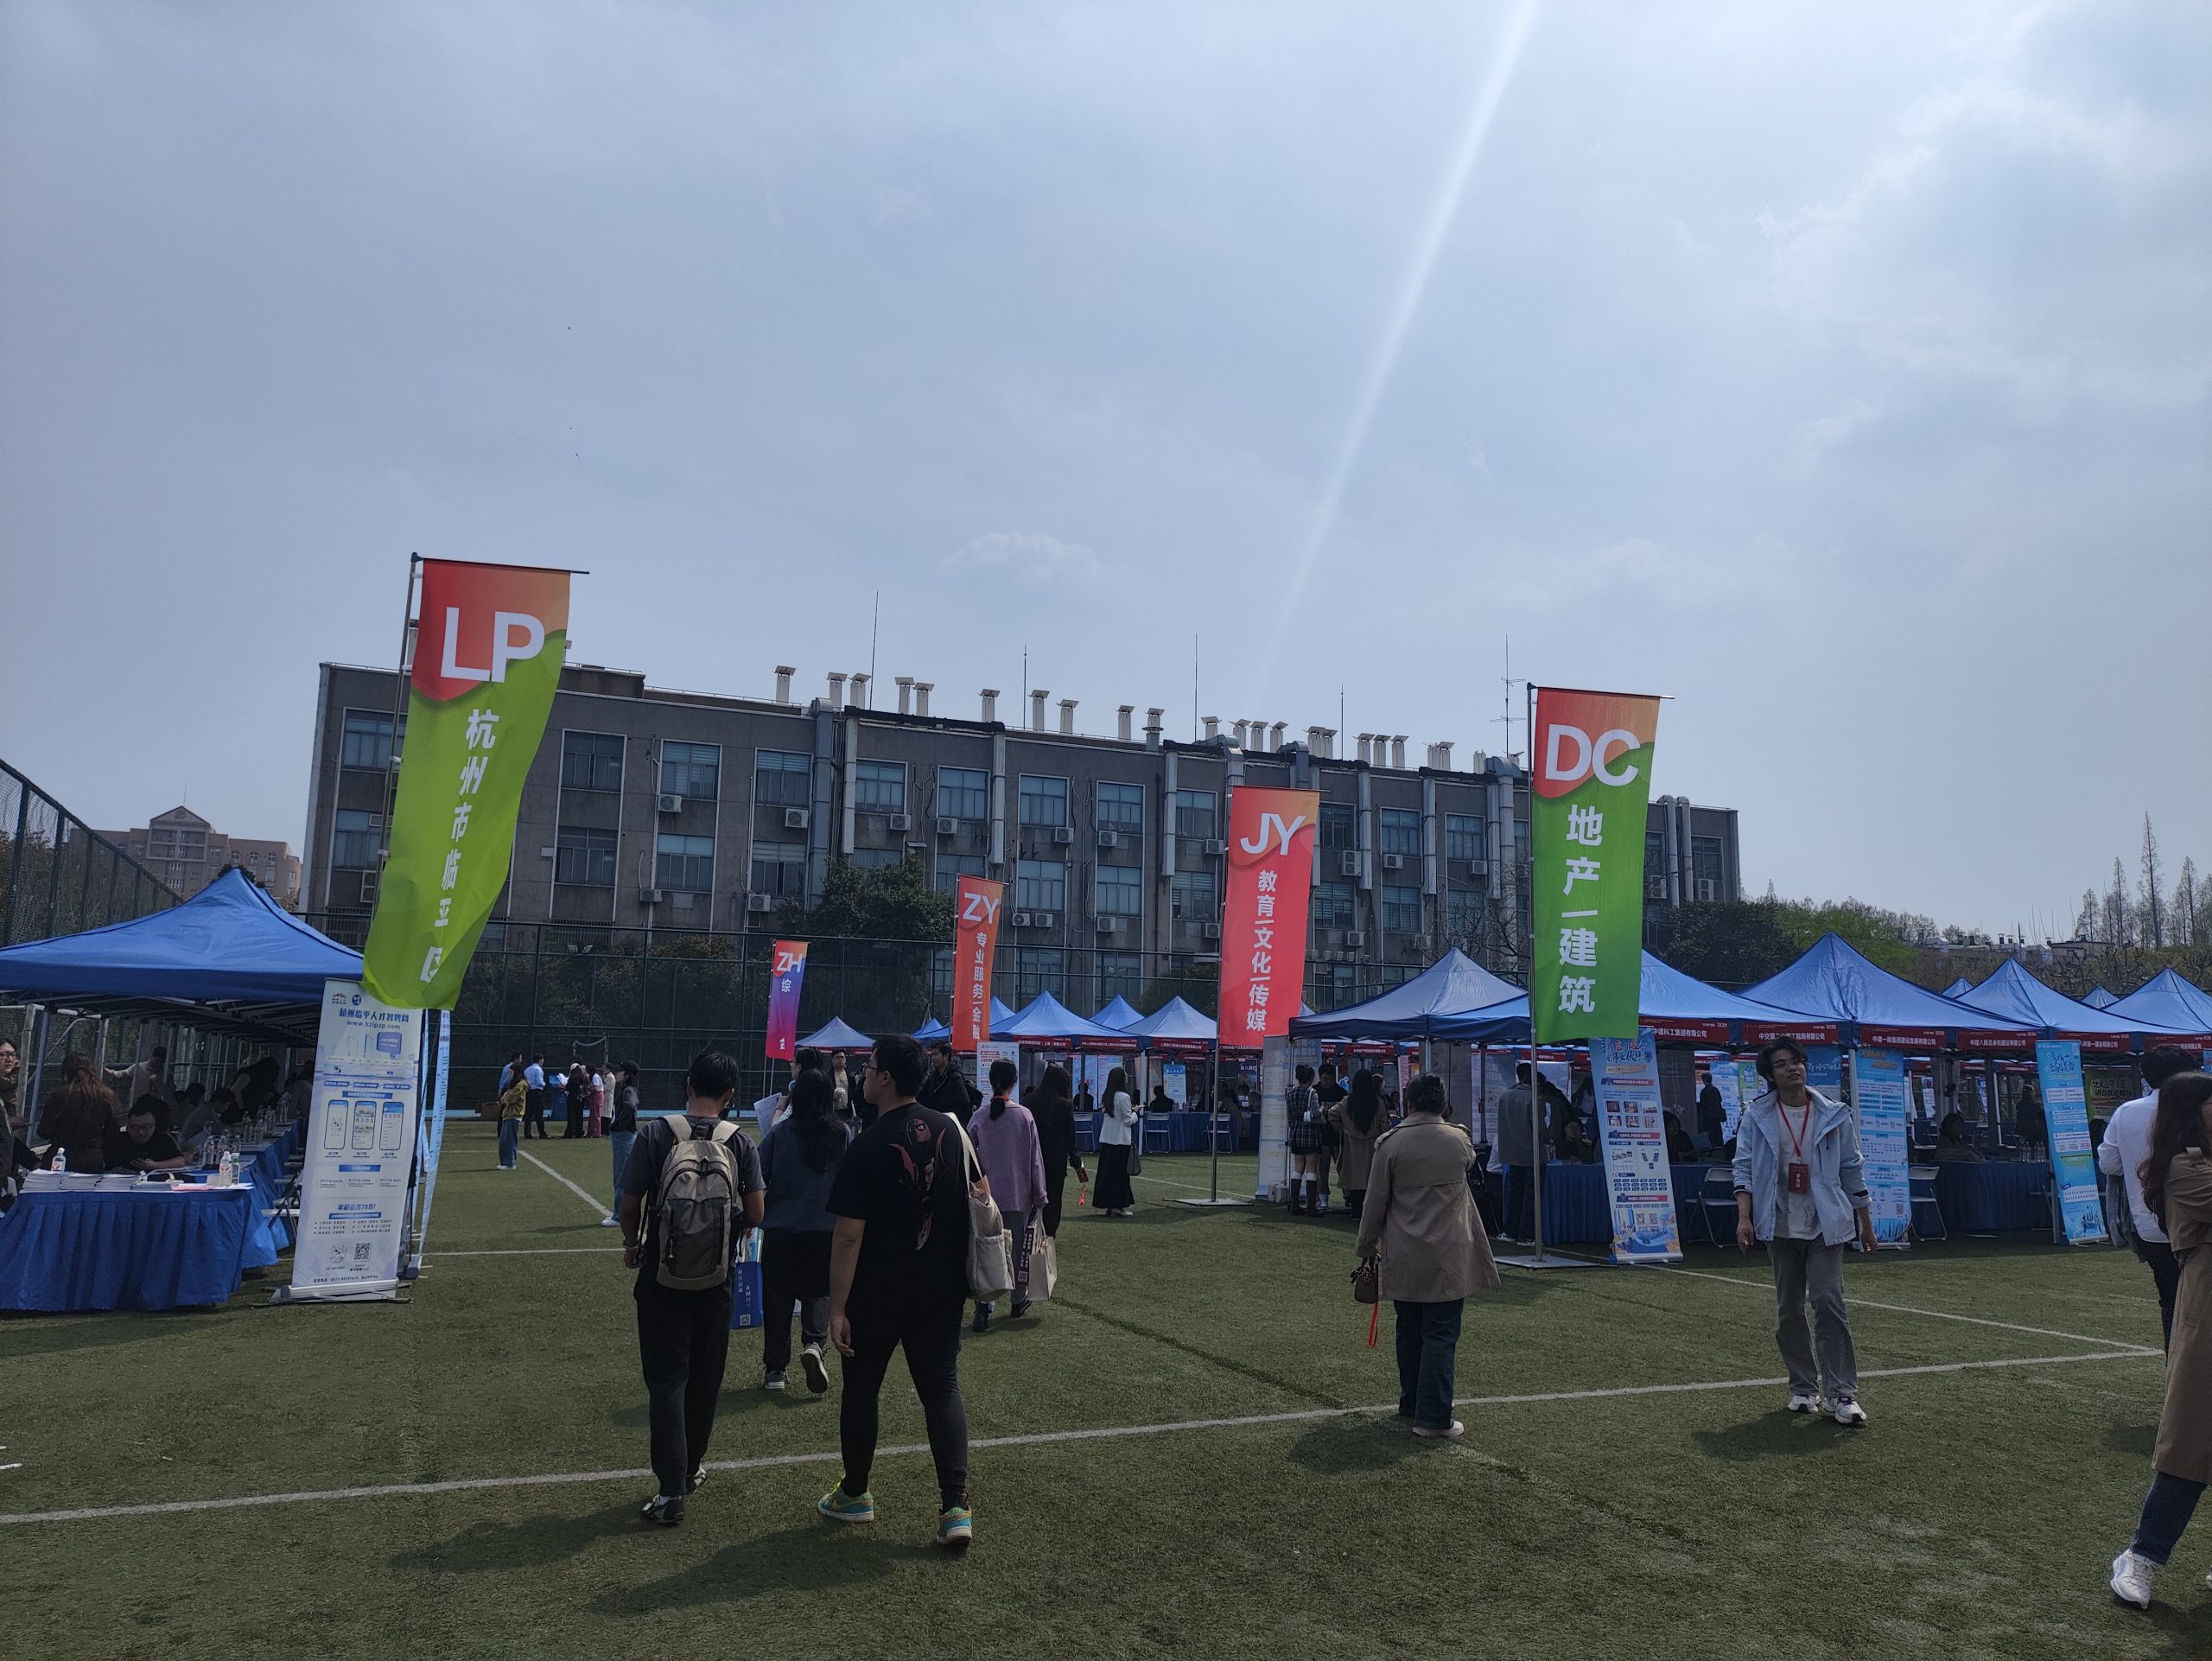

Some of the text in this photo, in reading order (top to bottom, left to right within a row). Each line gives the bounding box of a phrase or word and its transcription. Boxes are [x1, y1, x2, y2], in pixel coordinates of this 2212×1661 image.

[440, 606, 545, 683] LP
[1545, 723, 1641, 787] DC
[1241, 812, 1306, 856] JY
[963, 892, 1000, 925] ZY
[776, 951, 803, 973] ZH
[1653, 1028, 1707, 1038] 中建科工集团有限公司
